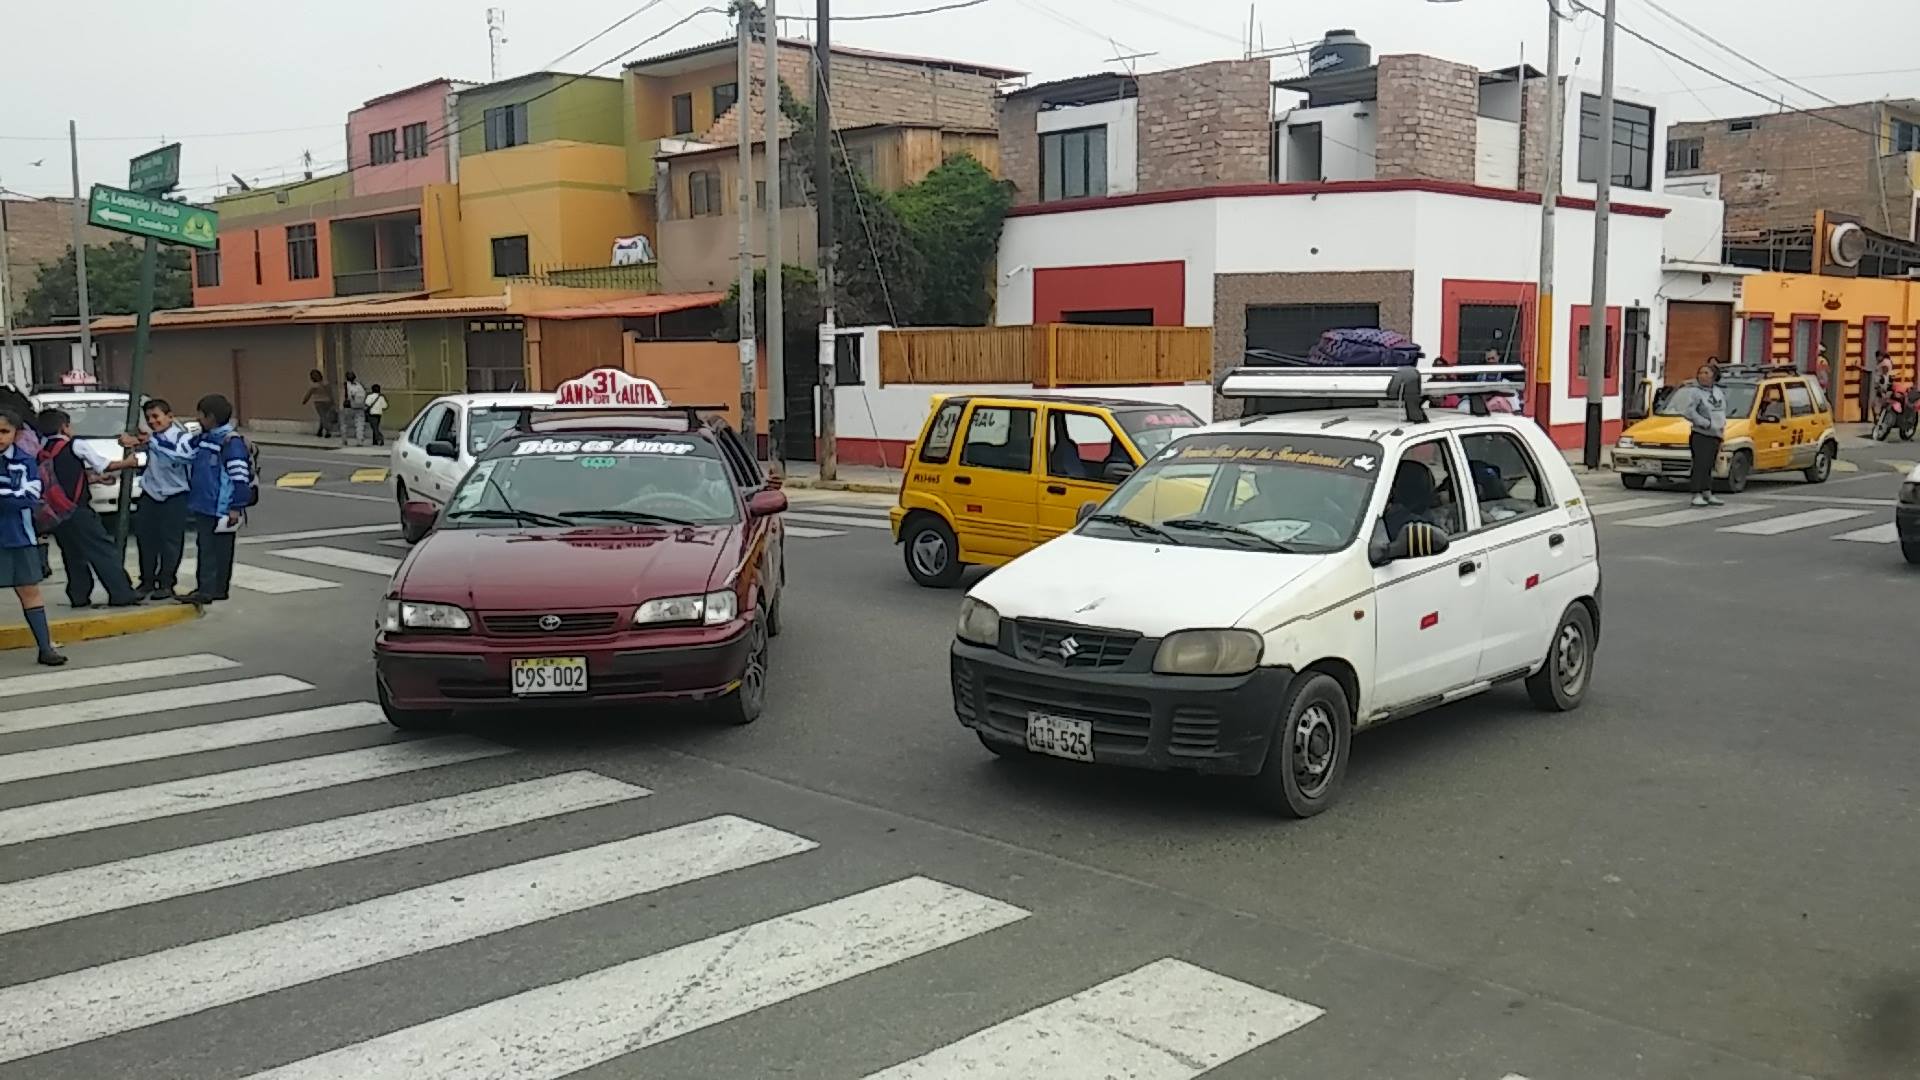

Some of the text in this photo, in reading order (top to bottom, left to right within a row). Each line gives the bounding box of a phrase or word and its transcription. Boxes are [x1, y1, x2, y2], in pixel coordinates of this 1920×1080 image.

[110, 191, 150, 211] Leoncio
[150, 200, 180, 218] Prado
[592, 372, 616, 393] 31
[556, 384, 583, 405] SAN
[616, 384, 657, 405] CALETA
[513, 438, 695, 455] Dios es Amor
[515, 665, 583, 688] C9S-002
